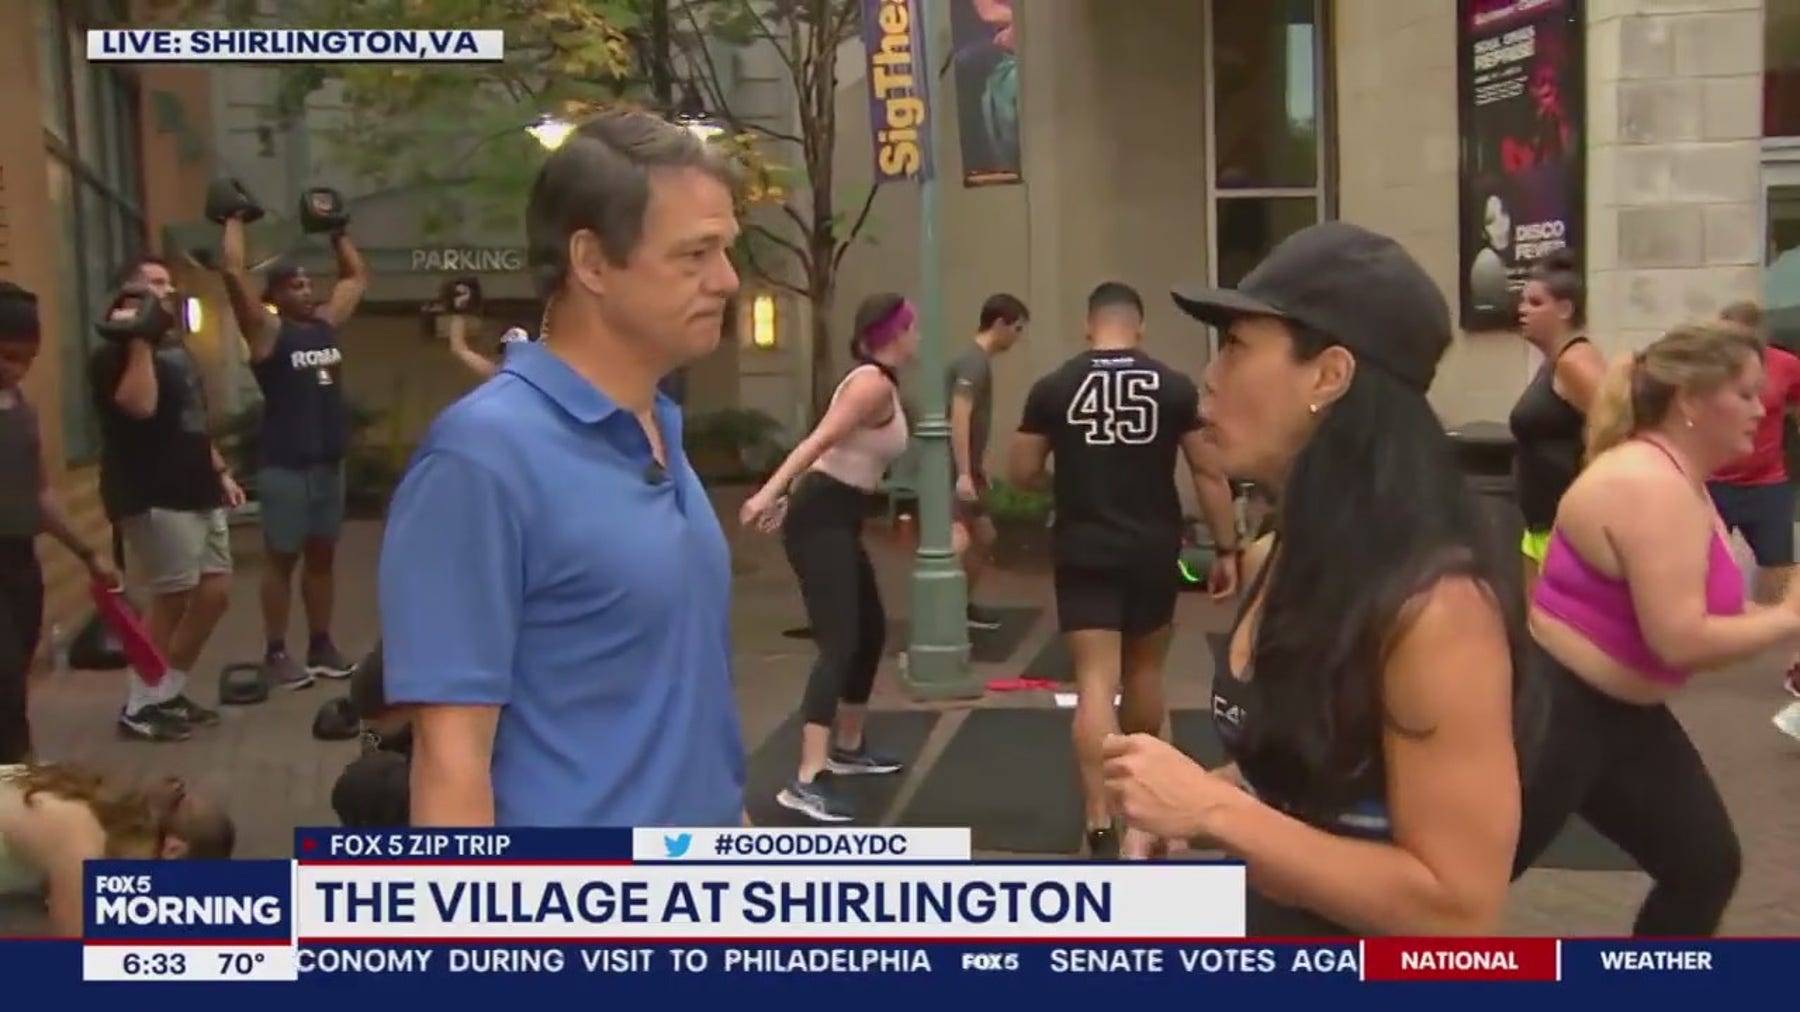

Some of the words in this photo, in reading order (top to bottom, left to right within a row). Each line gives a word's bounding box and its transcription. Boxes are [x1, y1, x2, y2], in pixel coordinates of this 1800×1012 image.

[872, 0, 925, 176] SigThe
[411, 248, 521, 271] PARKING
[1066, 370, 1160, 444] 45
